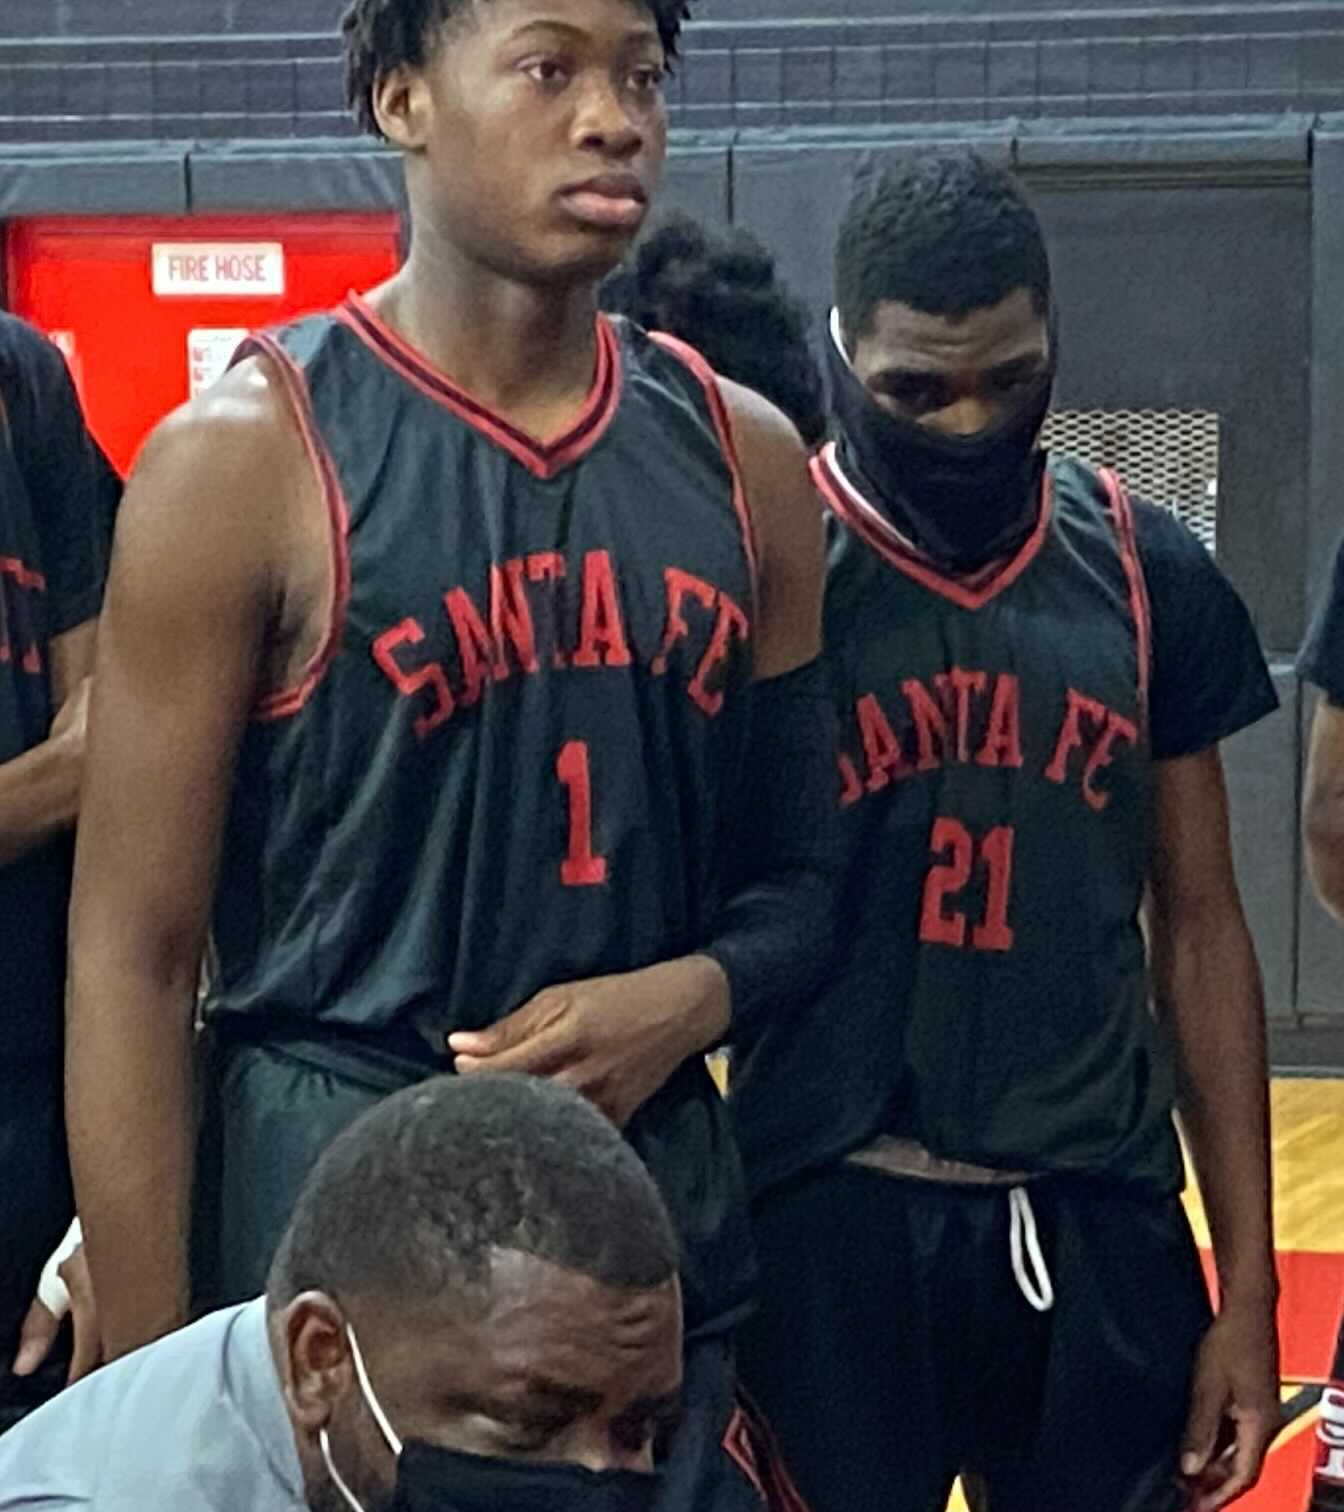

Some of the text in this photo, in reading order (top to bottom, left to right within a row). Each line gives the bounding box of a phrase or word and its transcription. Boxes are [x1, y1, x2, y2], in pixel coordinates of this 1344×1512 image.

[167, 254, 267, 282] FIRE HOSE
[371, 548, 632, 739] SANTA
[555, 739, 608, 887] 1
[1043, 686, 1139, 812] FE
[918, 815, 1016, 952] 21
